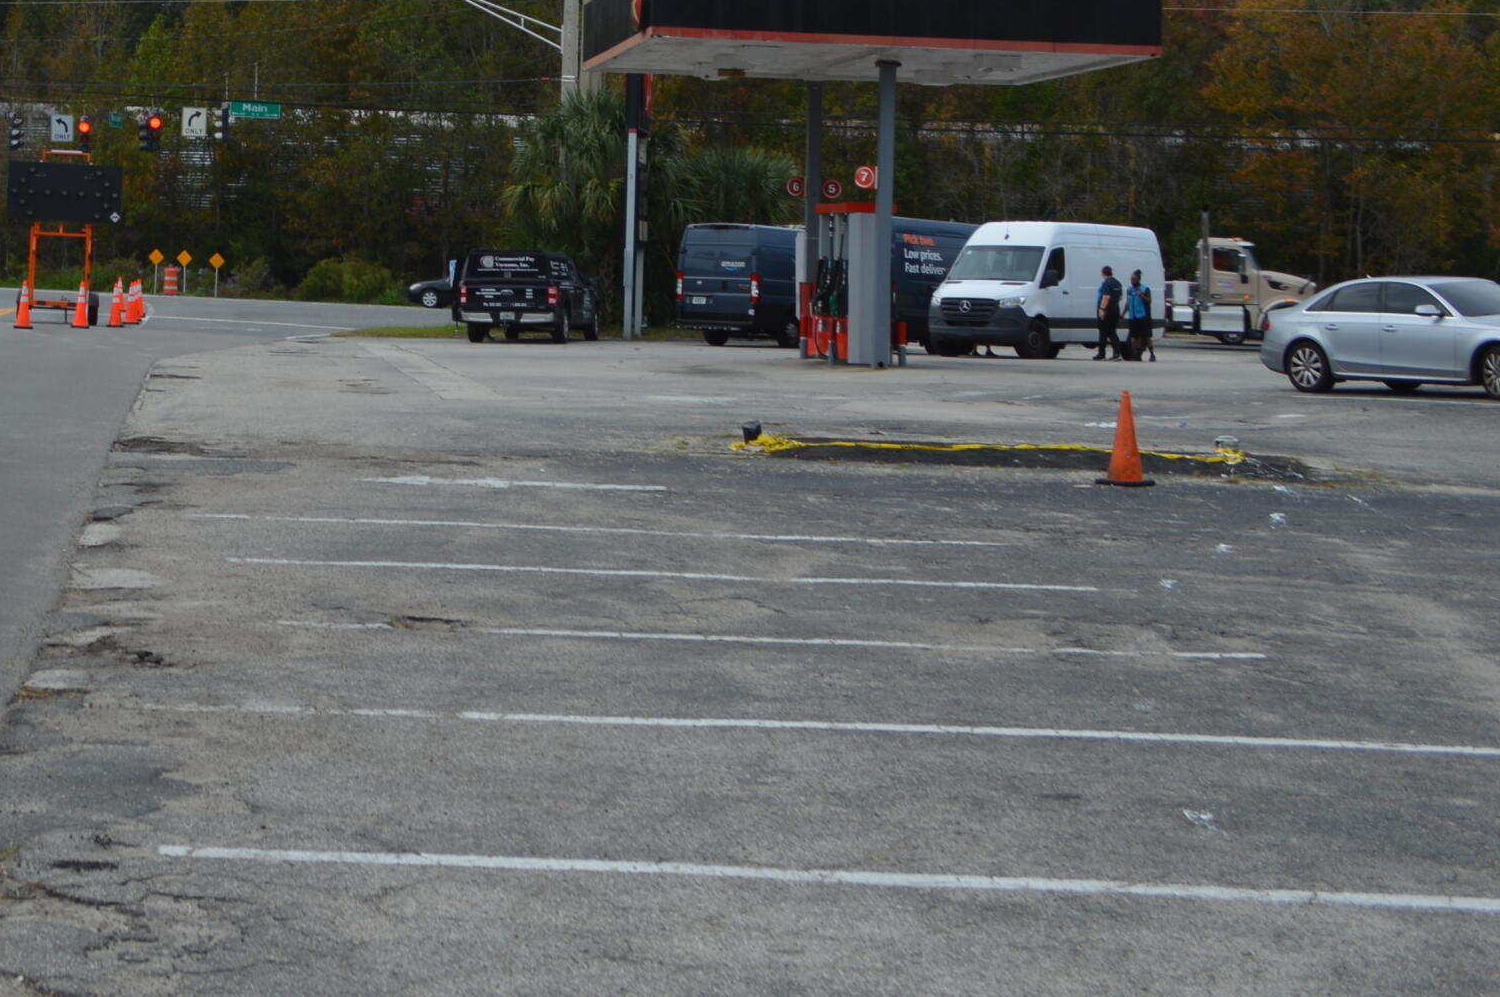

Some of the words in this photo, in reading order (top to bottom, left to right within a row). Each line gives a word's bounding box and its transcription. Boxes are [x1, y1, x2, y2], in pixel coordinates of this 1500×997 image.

[242, 103, 268, 112] Main
[860, 171, 869, 182] 7
[792, 182, 800, 192] 6
[827, 184, 837, 194] 5
[903, 248, 919, 259] Low
[920, 250, 943, 262] prices.
[905, 262, 920, 274] Fast
